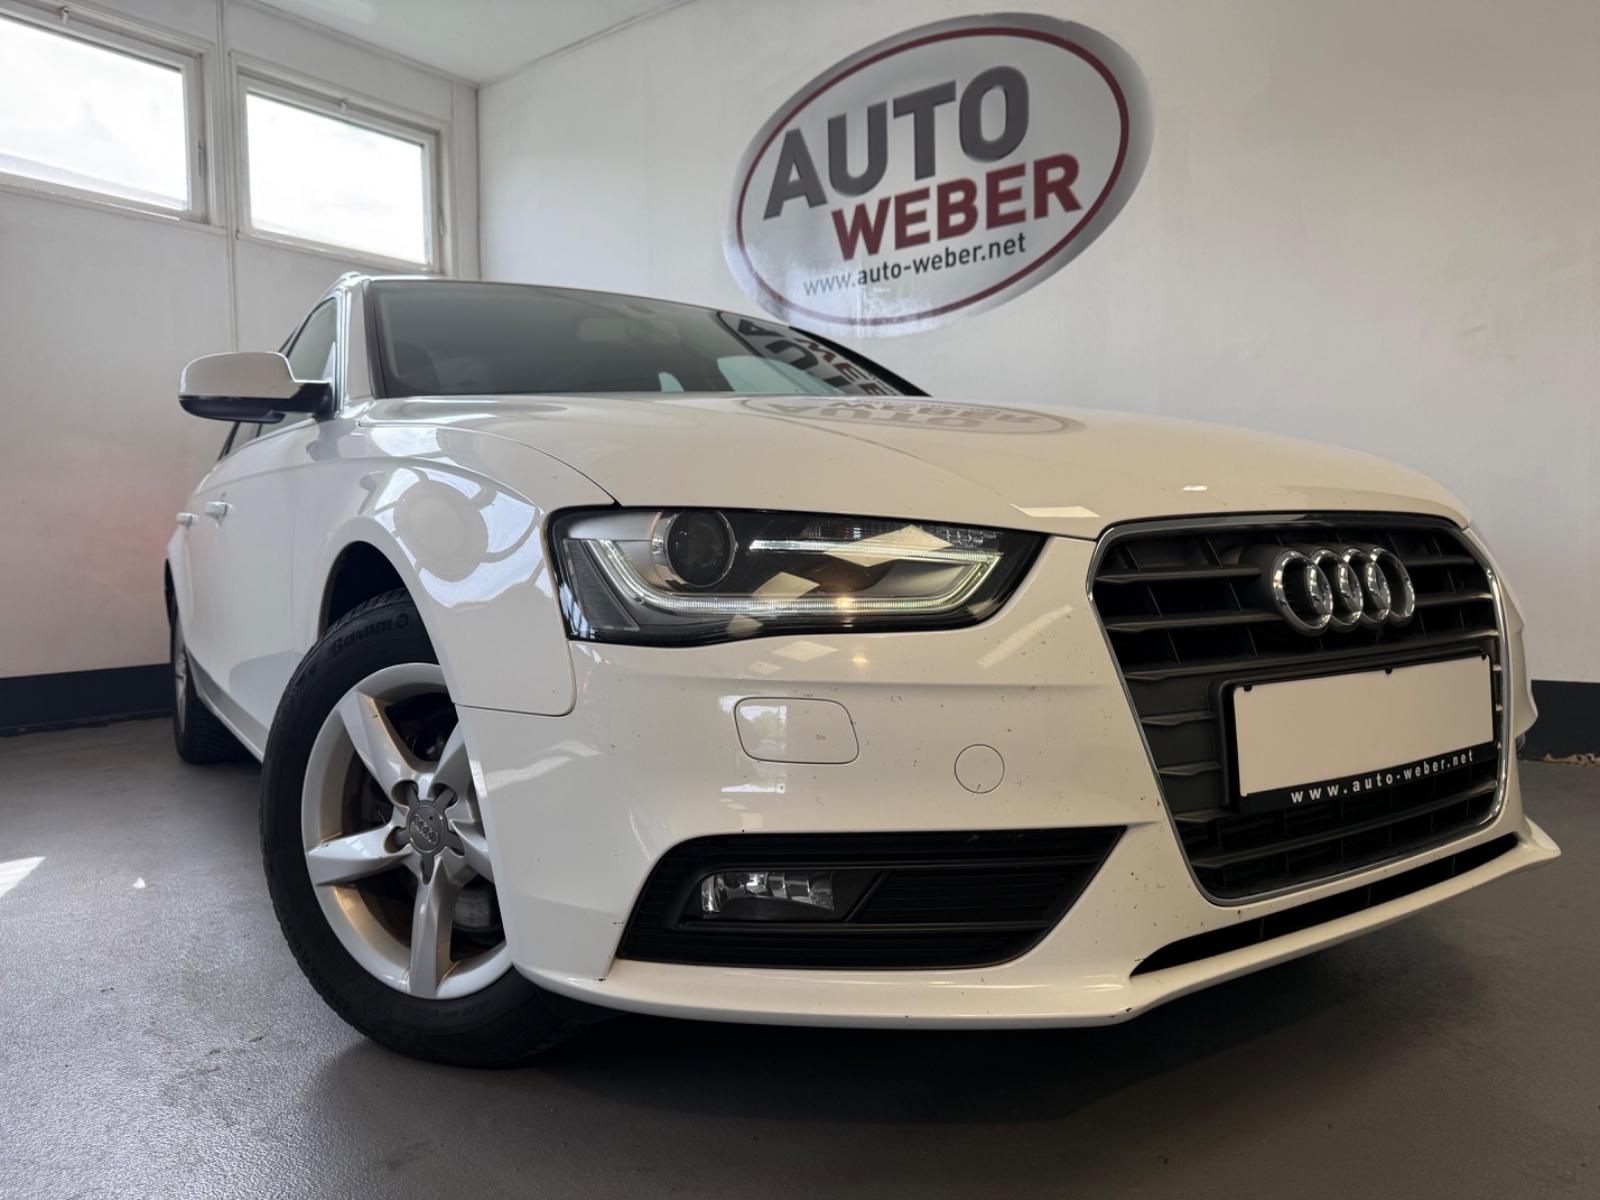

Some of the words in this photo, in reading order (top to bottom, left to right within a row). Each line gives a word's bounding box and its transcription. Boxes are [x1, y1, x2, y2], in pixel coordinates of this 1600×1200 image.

[763, 66, 1030, 220] AUTO
[831, 153, 1082, 261] WEBER
[803, 232, 1026, 297] www.auto-weber.net
[332, 618, 392, 657] Barum
[1291, 750, 1474, 804] www.auto-weber.net
